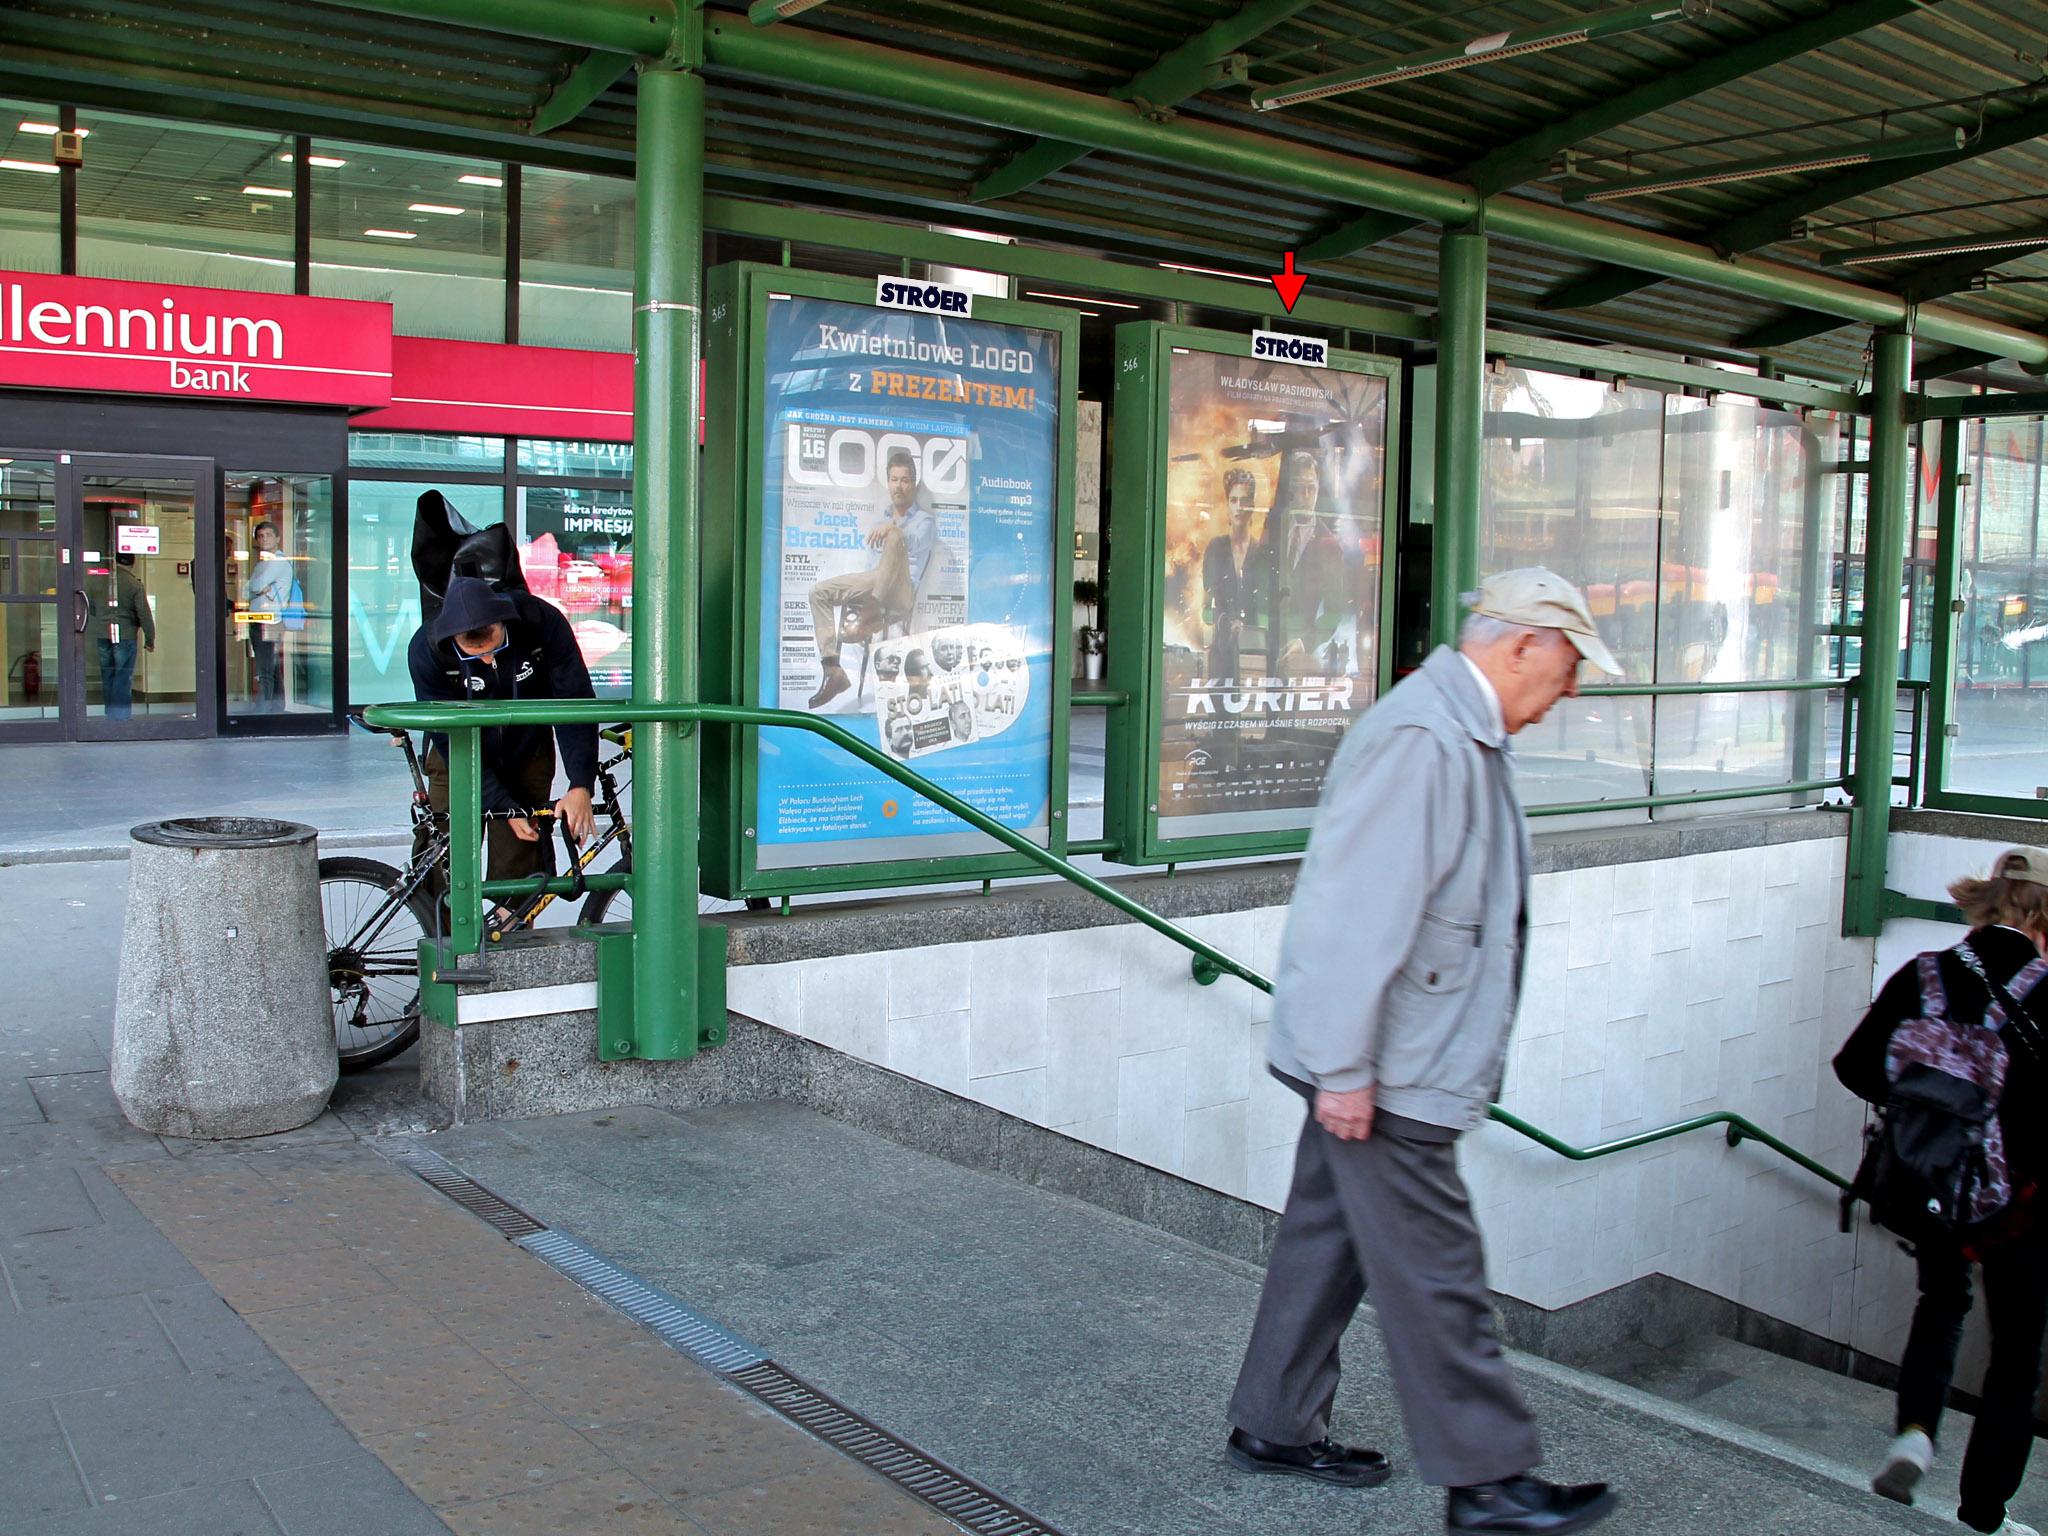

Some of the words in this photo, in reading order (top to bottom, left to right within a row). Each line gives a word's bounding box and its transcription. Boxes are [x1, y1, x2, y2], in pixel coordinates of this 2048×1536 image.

[880, 282, 969, 314] STRÖER
[0, 283, 283, 359] lennium
[819, 324, 964, 365] Kwietniowe
[970, 345, 1034, 374] LOGO
[1255, 336, 1325, 363] STRÖER
[170, 360, 251, 393] bank
[871, 370, 1035, 411] PREZENTEM!
[1220, 375, 1279, 394] WŁADYSŁAW
[1279, 383, 1333, 400] PASIKOWSKI
[787, 410, 802, 419] JAK
[837, 415, 856, 424] JEST
[858, 417, 894, 428] KAMERKA
[802, 439, 826, 458] 16
[981, 476, 1032, 490] Audiobook
[564, 504, 591, 514] Karta
[1010, 495, 1032, 506] mp3
[814, 511, 858, 527] Jacek
[785, 526, 866, 550] Braciak
[785, 555, 811, 564] STYL
[784, 601, 809, 610] SEKS:
[917, 602, 966, 615] ROWERY
[1184, 677, 1354, 714] KURIER
[1185, 718, 1217, 731] WYŚCIG
[1217, 720, 1224, 729] Z
[1224, 718, 1258, 729] CZASEM
[1258, 717, 1294, 729] WŁAŚNIE
[1294, 718, 1307, 729] SIĘ
[1308, 716, 1351, 729] ROZPOCZĄŁ
